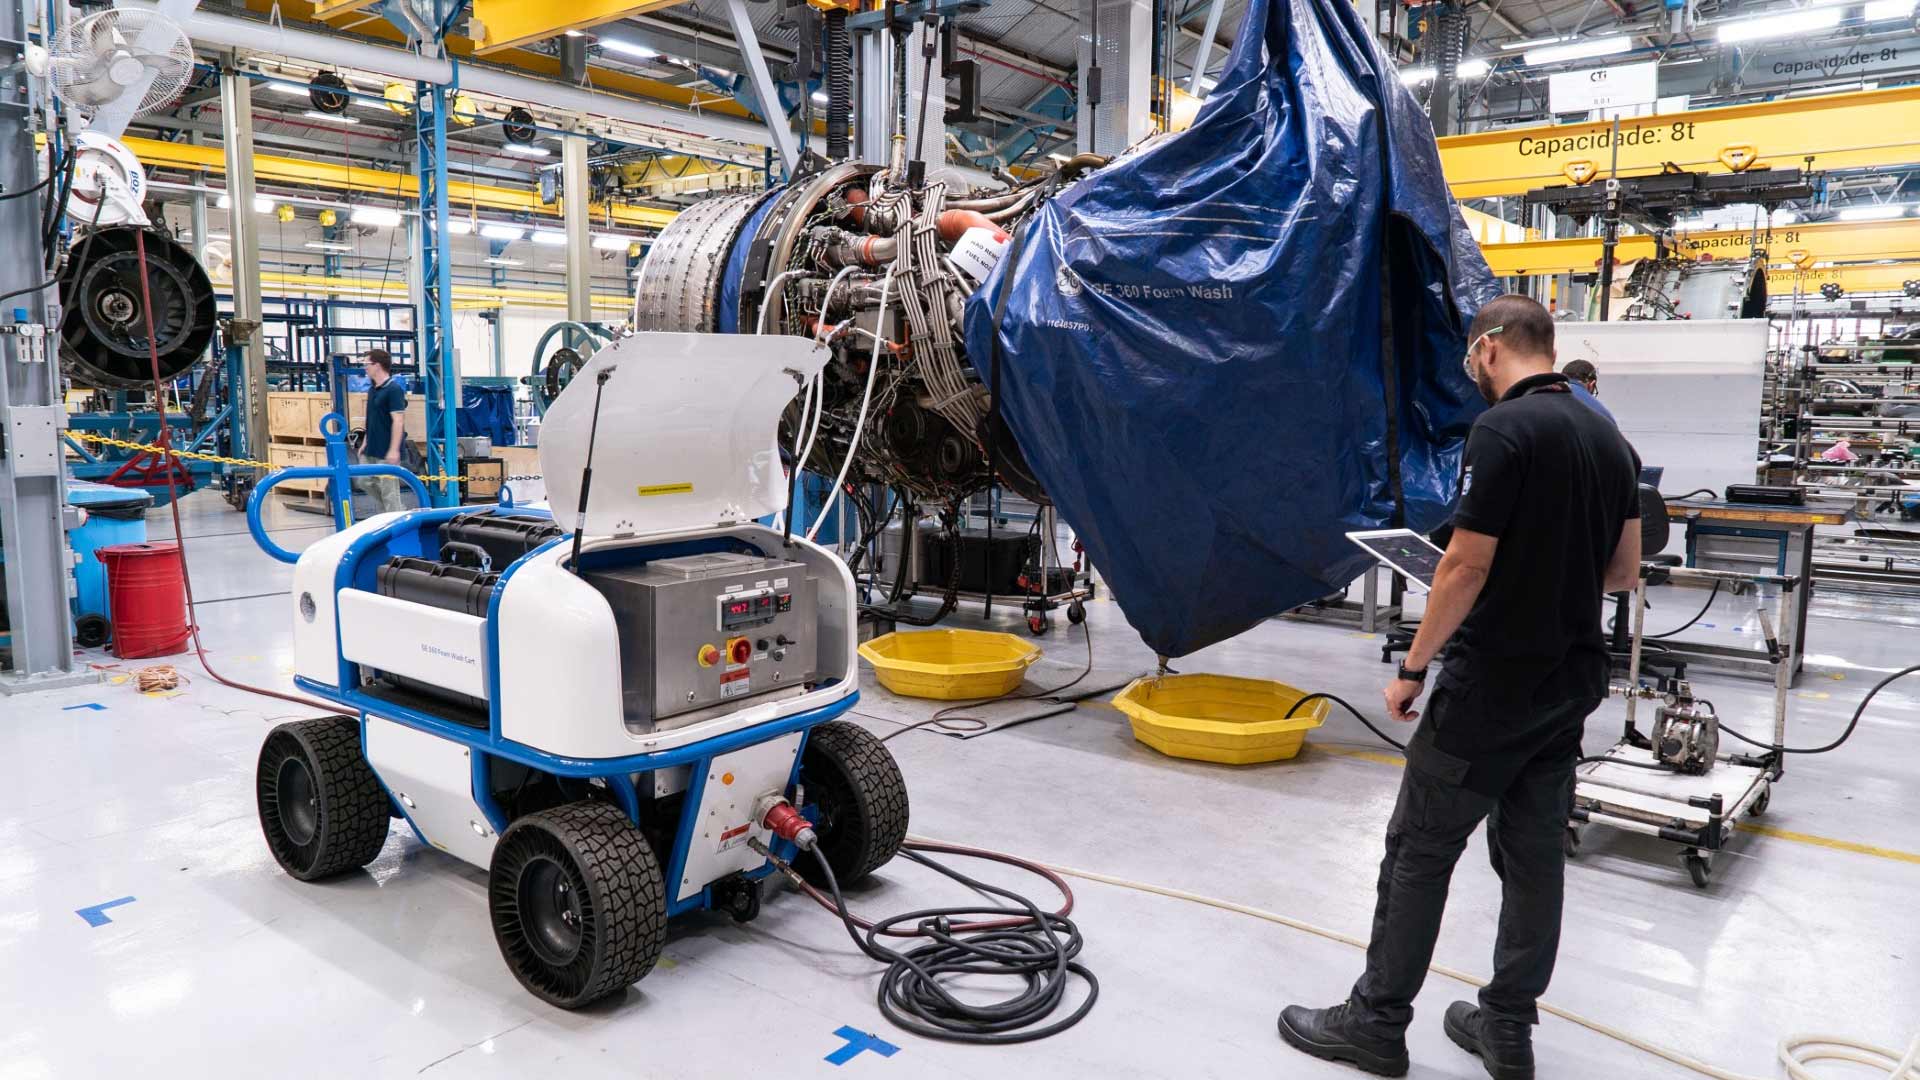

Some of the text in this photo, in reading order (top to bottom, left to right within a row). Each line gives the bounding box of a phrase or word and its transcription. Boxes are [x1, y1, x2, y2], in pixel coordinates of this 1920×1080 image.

[1773, 48, 1898, 75] Capacidade: 8t
[1519, 121, 1695, 158] Capacidade: 8t
[1785, 231, 1800, 243] 8t
[965, 249, 980, 263] FUEL
[1116, 284, 1139, 298] 360
[1143, 285, 1185, 299] Foam
[1187, 284, 1232, 299] Wash
